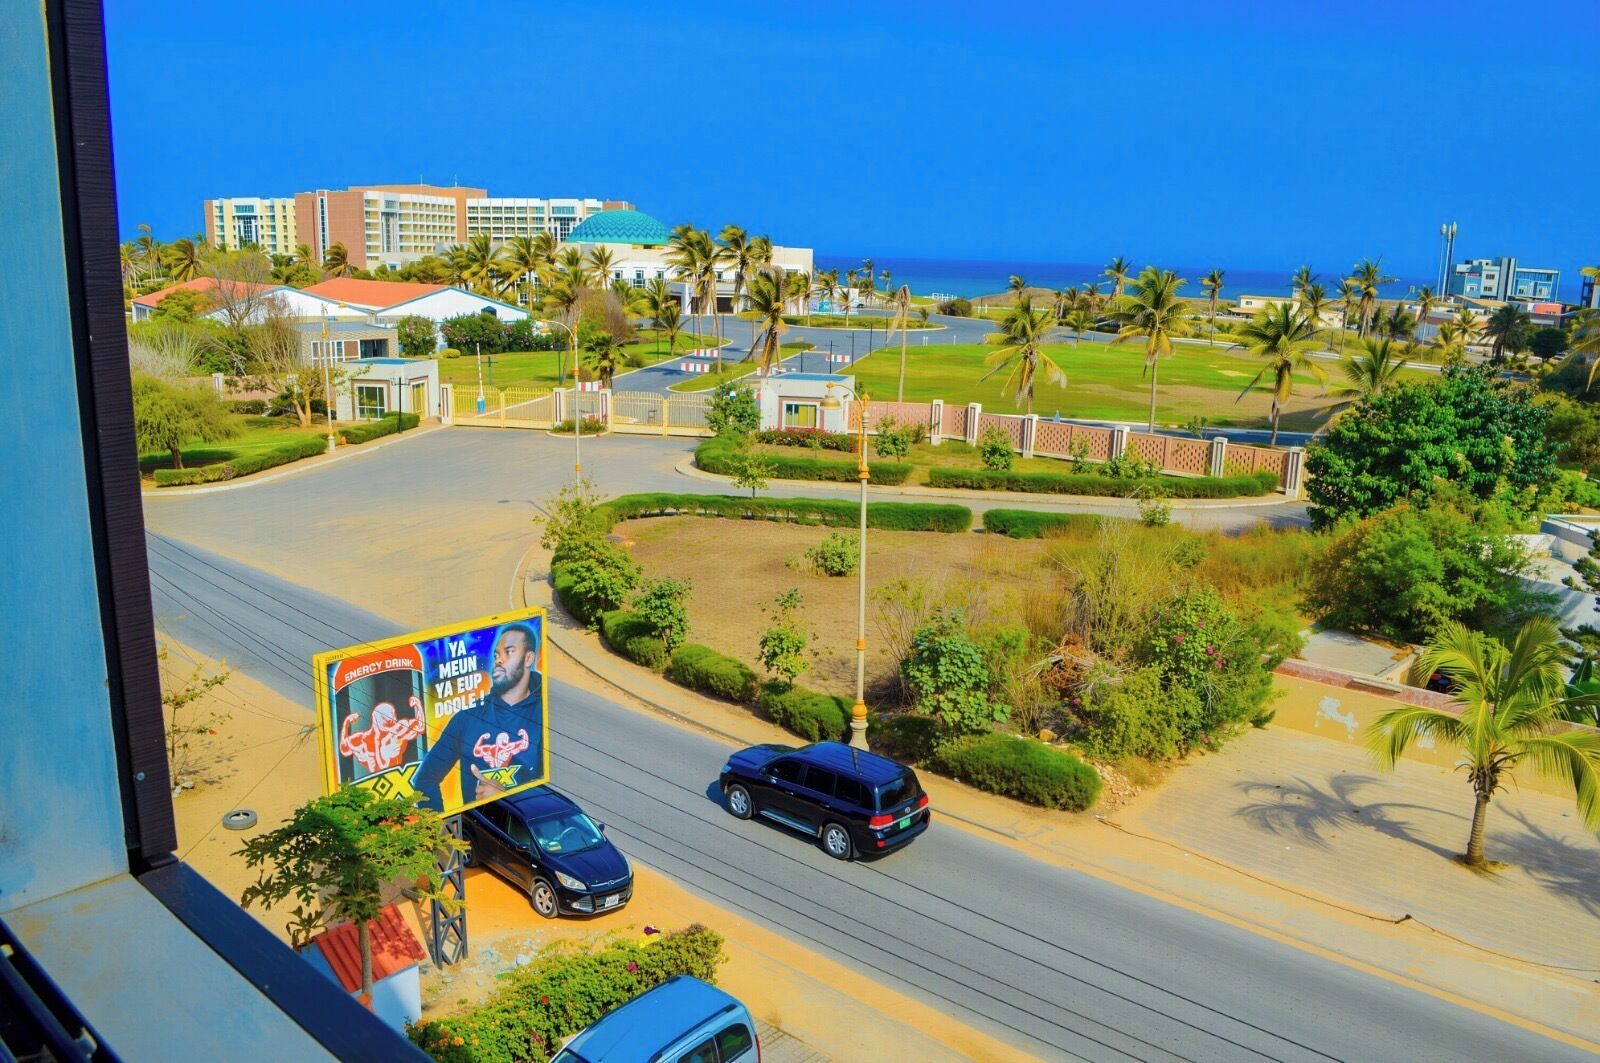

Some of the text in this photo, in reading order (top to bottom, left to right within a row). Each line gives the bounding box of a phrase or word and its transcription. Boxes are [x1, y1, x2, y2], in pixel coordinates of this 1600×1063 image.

[448, 640, 467, 658] YA
[385, 658, 414, 669] DRINK
[438, 655, 477, 680] MEUN
[434, 672, 483, 699] YA EUP
